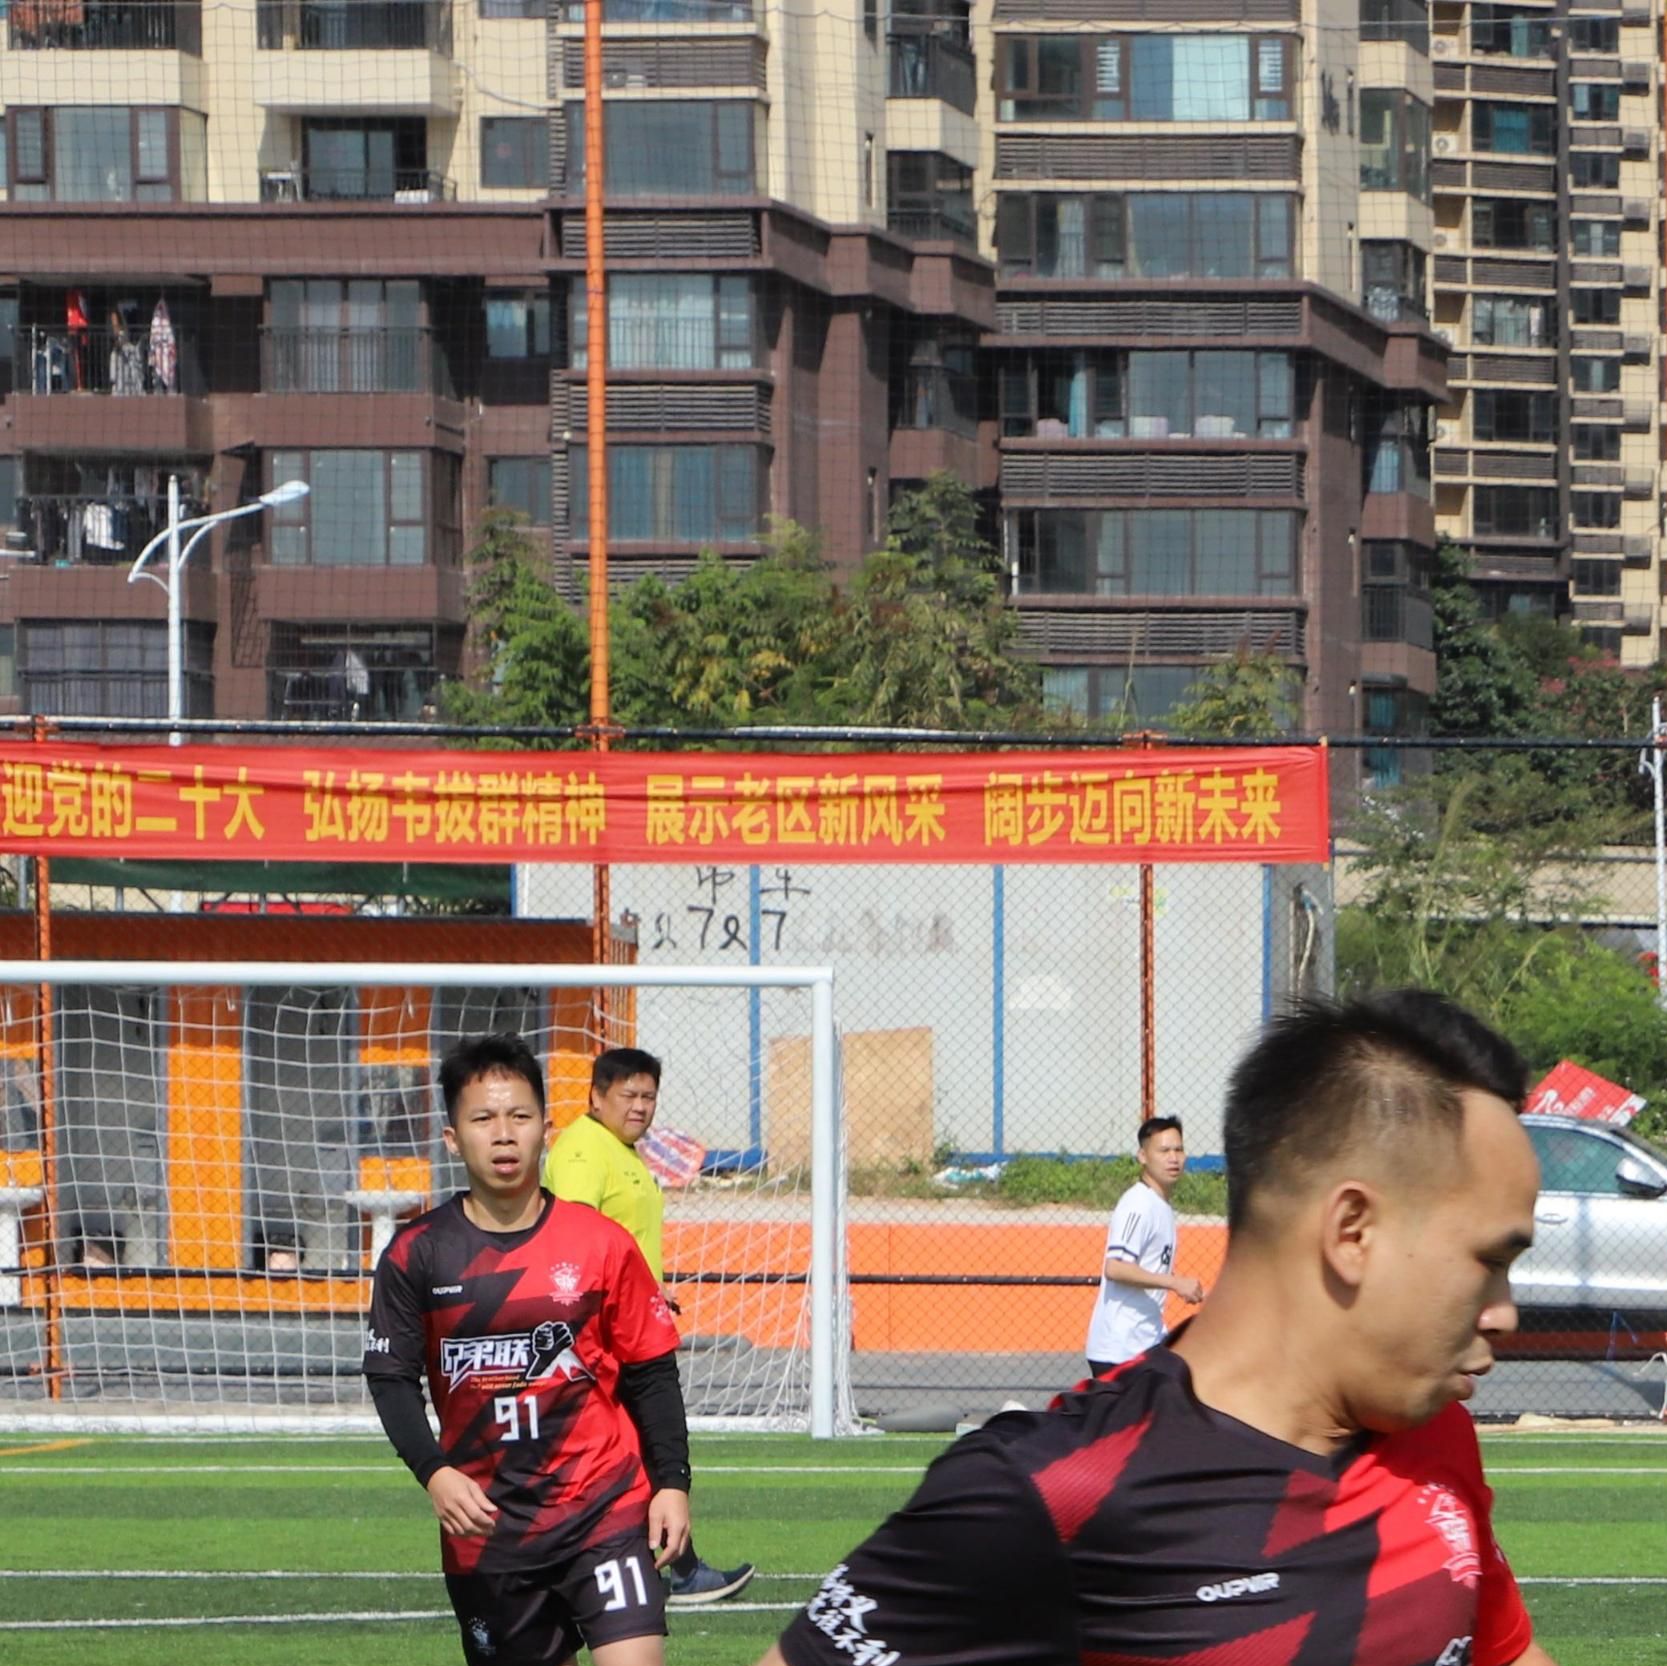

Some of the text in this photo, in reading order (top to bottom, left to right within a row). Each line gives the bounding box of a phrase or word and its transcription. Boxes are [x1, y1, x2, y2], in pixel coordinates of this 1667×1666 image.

[1, 760, 1282, 847] 迎党的二十大 弘扬韦拔群精神 展示老区新风采 阔步迈向新未来
[494, 1395, 539, 1441] 91
[594, 1556, 648, 1611] 91
